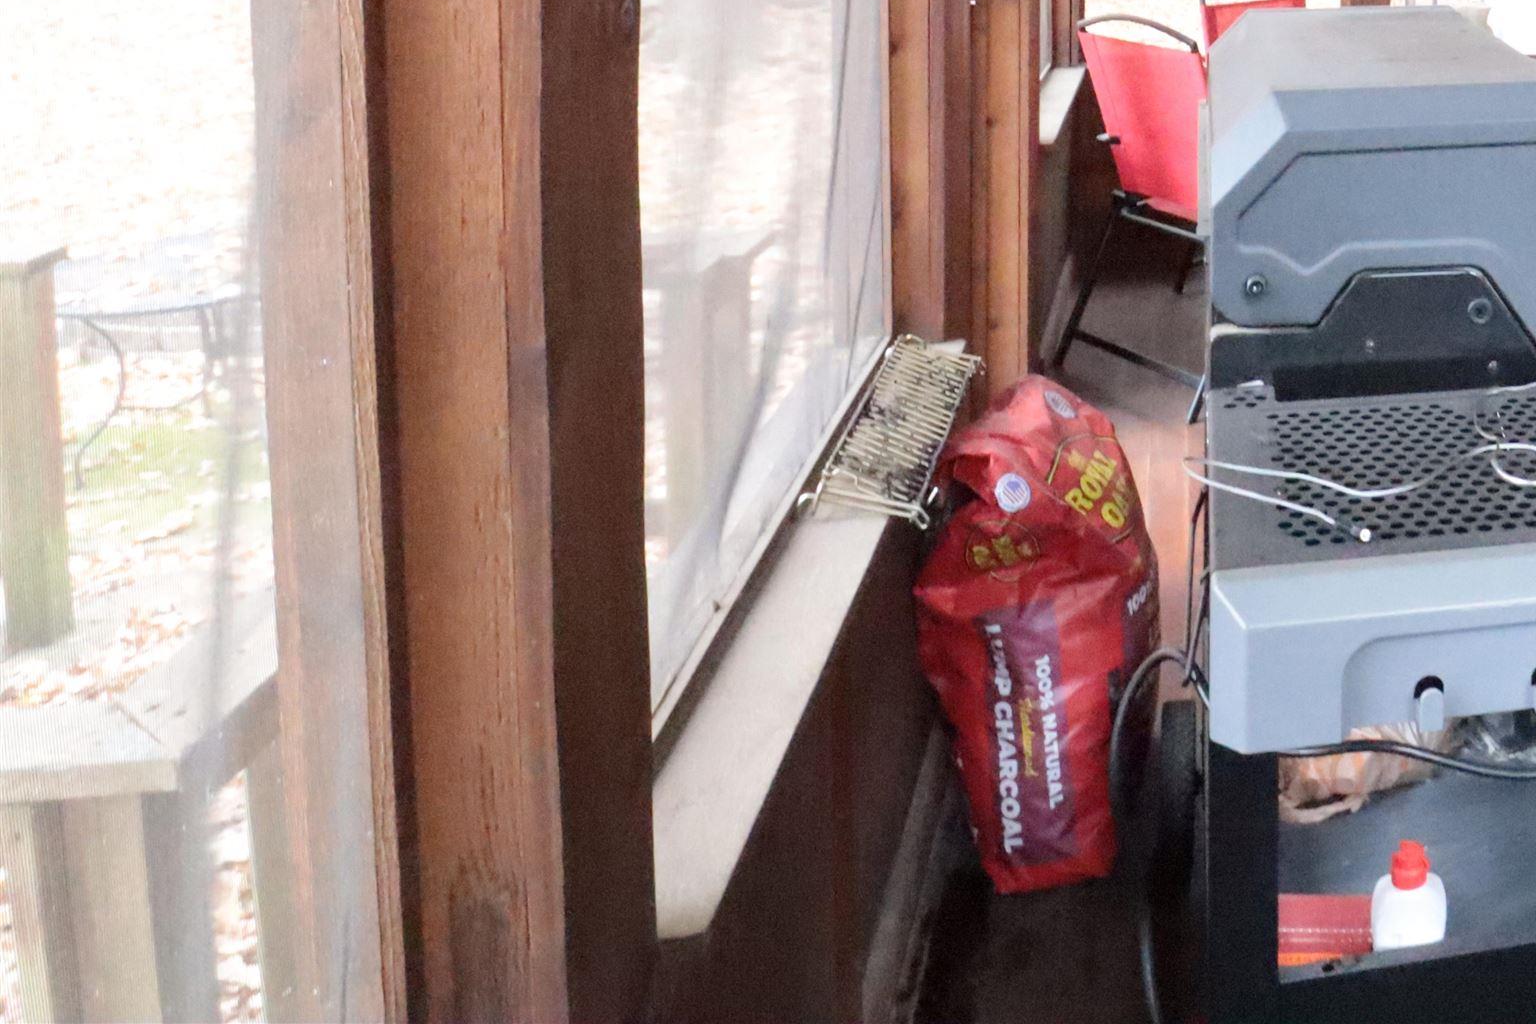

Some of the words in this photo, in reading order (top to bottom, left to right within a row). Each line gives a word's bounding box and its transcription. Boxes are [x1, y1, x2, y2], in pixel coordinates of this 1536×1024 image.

[1035, 653, 1056, 711] 100%
[994, 700, 1024, 854] CHARCOAL
[1042, 712, 1064, 810] NATURAL
